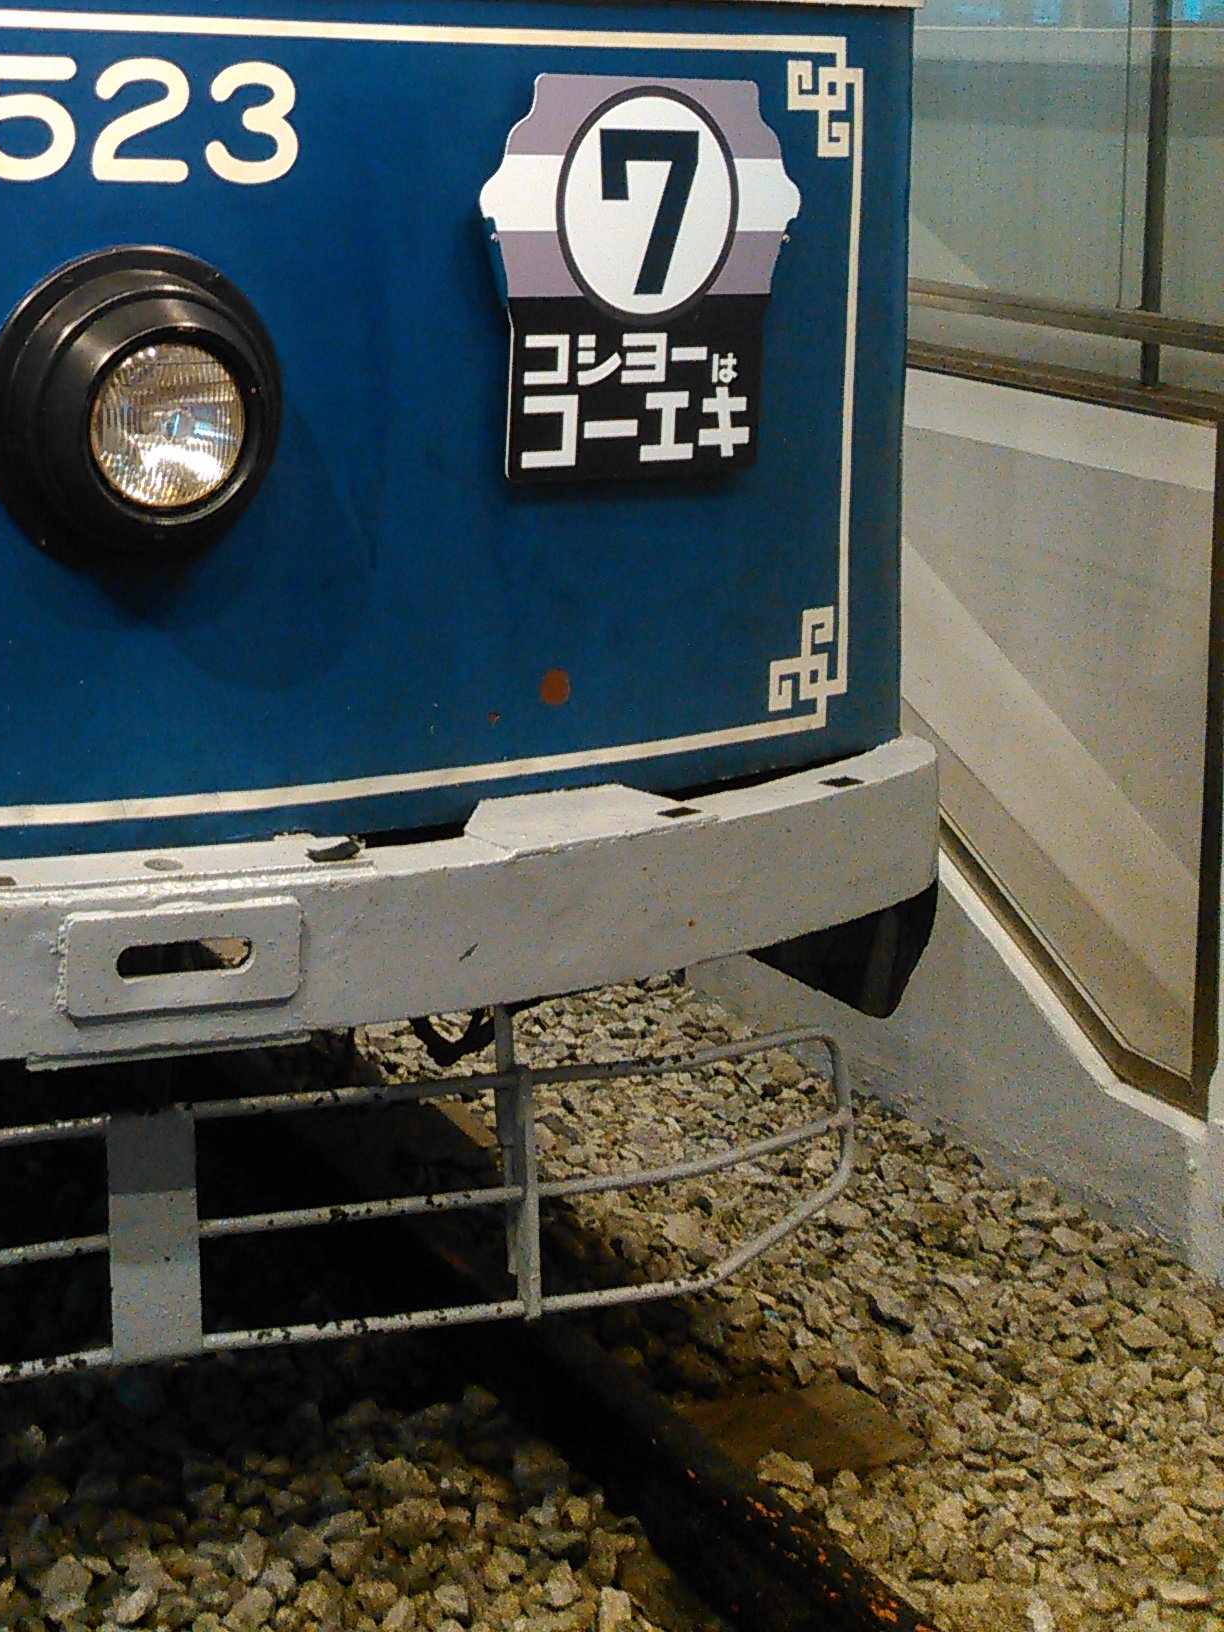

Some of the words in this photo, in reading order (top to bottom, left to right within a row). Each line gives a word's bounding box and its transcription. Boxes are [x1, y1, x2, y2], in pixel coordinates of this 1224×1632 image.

[599, 127, 701, 296] 7
[520, 385, 751, 469] コーエキ
